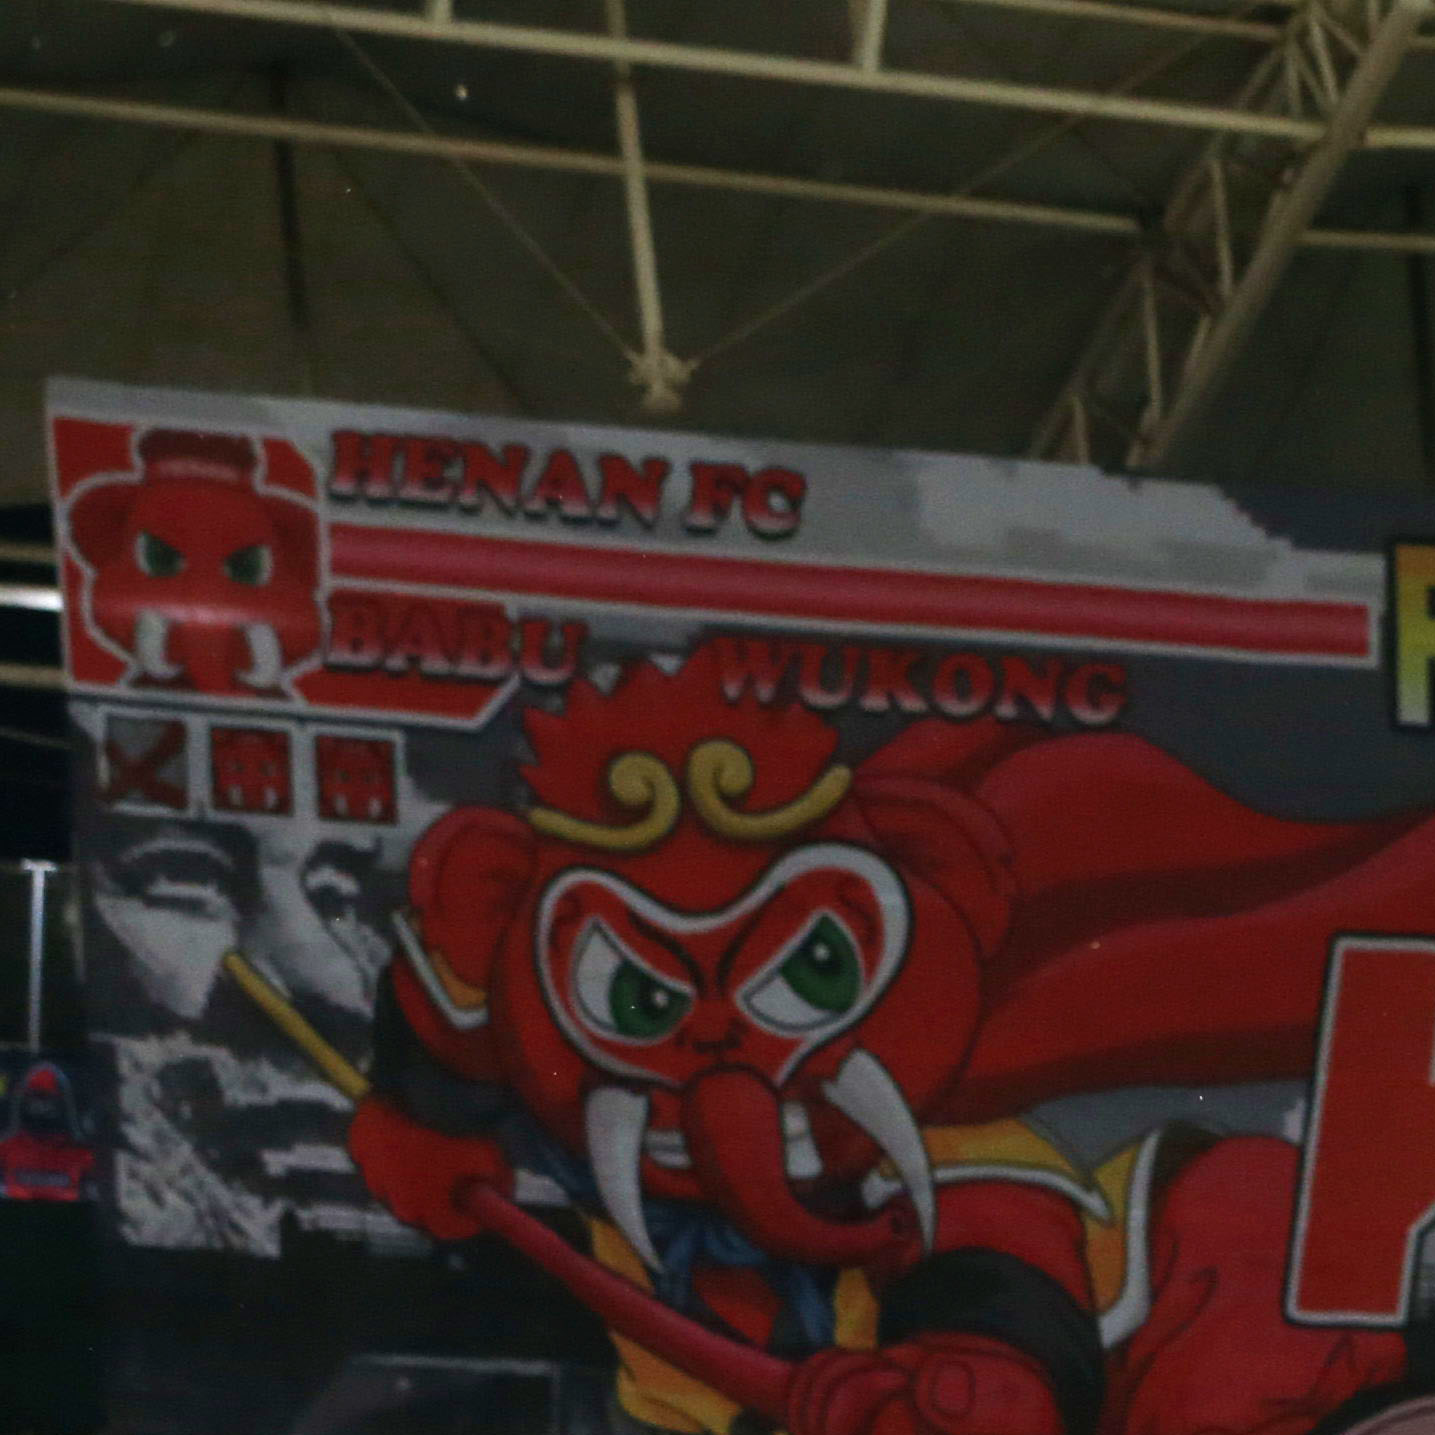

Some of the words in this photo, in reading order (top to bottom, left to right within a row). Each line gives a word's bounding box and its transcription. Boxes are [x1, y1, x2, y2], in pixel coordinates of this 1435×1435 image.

[328, 429, 668, 527] HENAN
[683, 461, 807, 540] FC
[326, 598, 587, 685] BABU
[711, 635, 1129, 727] WUKONG
